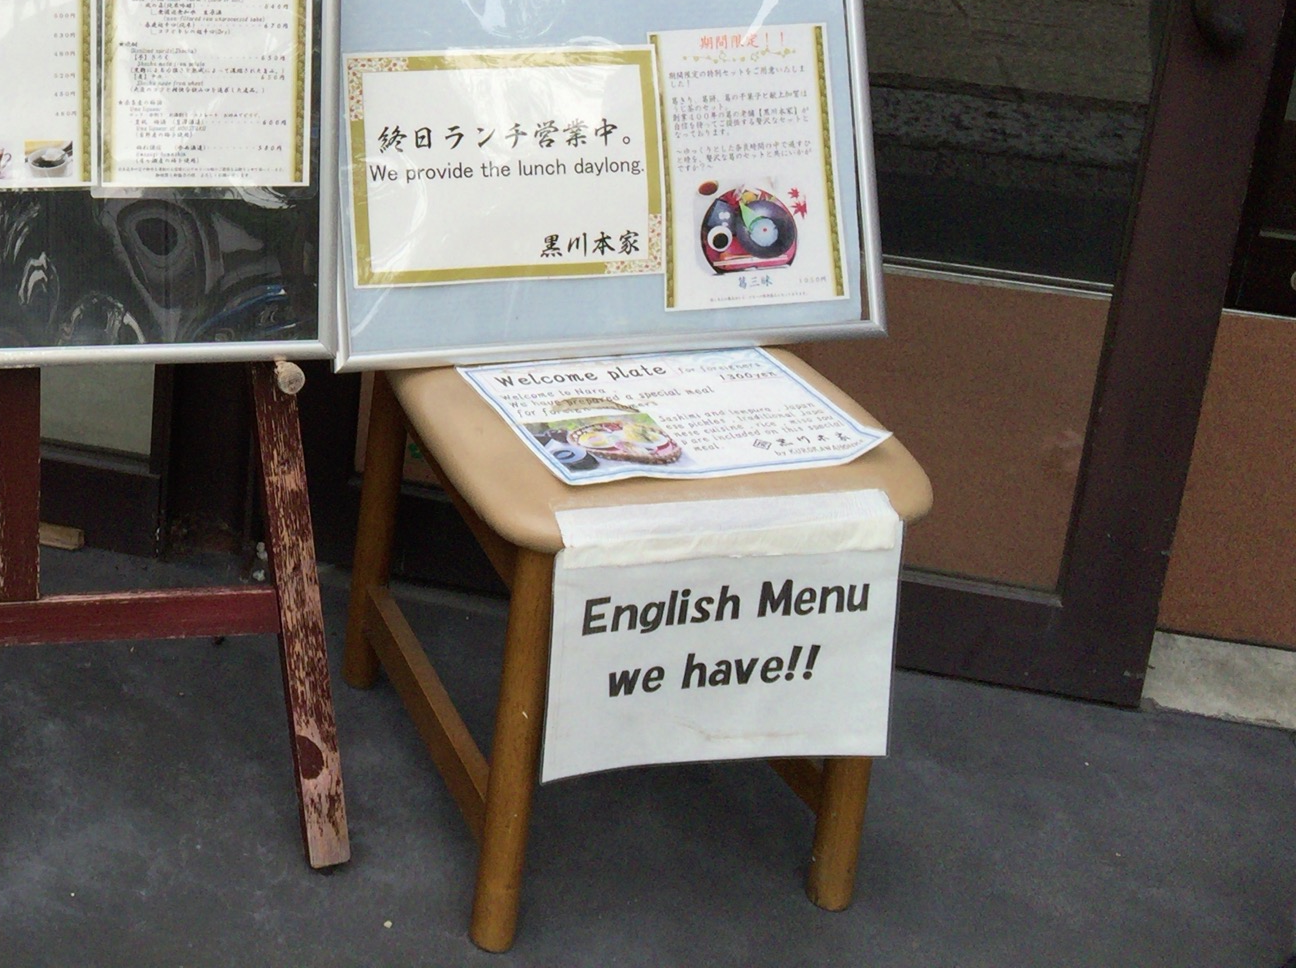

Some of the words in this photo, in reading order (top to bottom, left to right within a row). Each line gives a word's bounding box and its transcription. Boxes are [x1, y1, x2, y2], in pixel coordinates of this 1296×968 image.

[377, 117, 632, 154] 終日ランチ営業中。
[368, 164, 399, 182] We
[406, 162, 474, 184] provide
[480, 160, 511, 177] the
[518, 158, 567, 177] lunch
[573, 156, 646, 177] daylong.
[540, 230, 641, 258] 黒川本家
[493, 371, 599, 388] Welcome
[606, 364, 667, 381] plate
[581, 585, 741, 637] English
[756, 579, 871, 619] Menu
[607, 665, 665, 698] we
[681, 644, 822, 690] have!!
